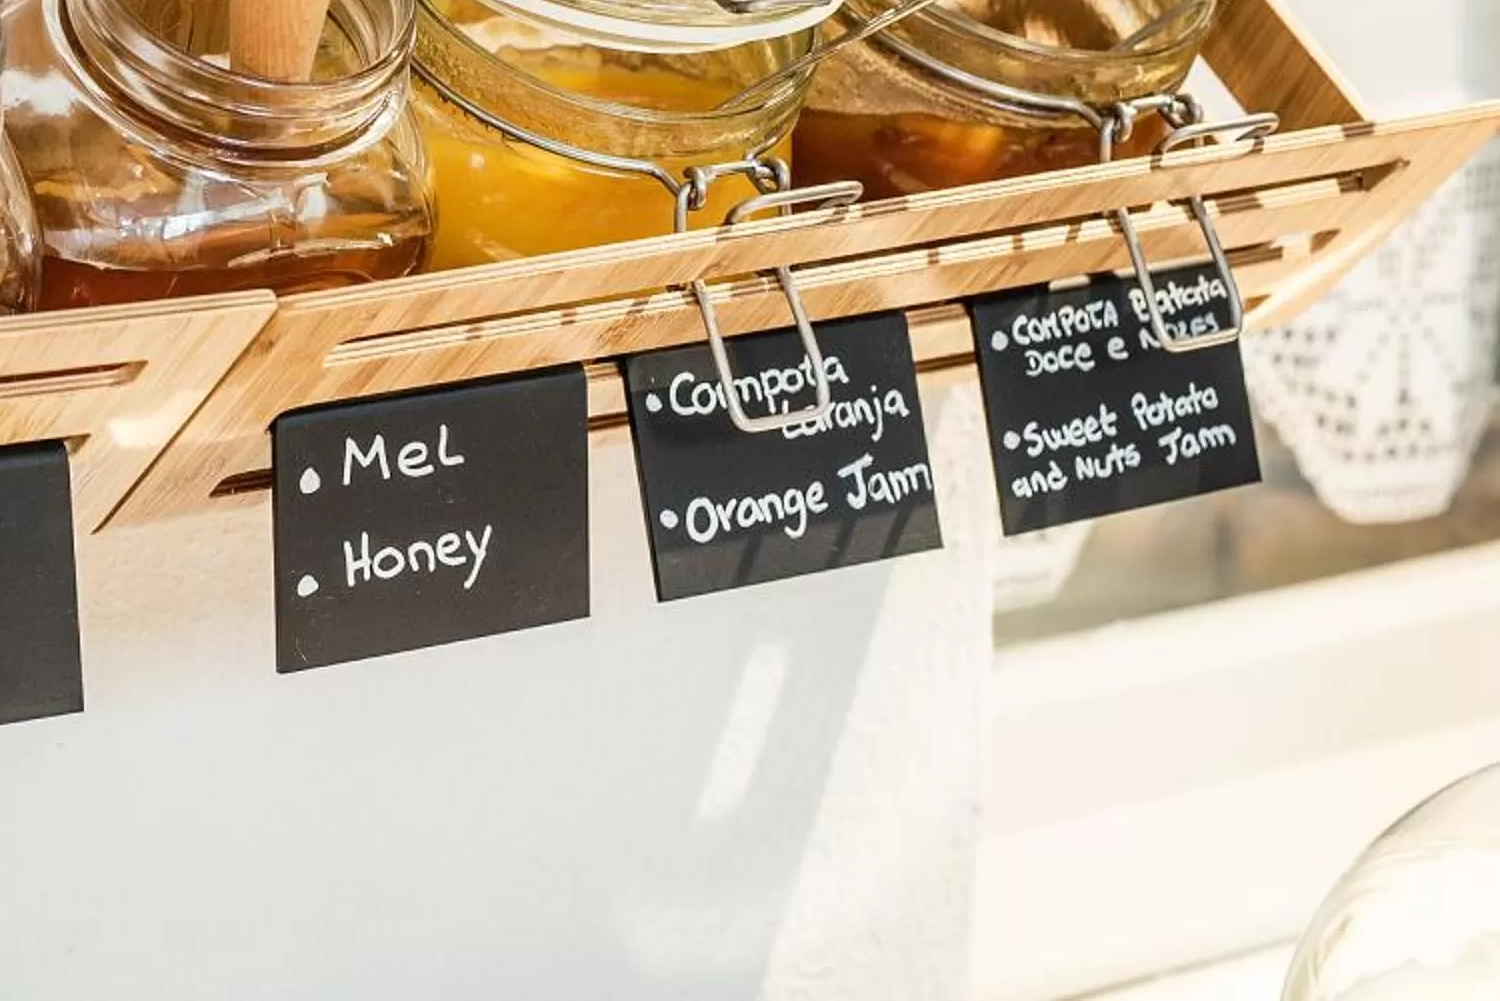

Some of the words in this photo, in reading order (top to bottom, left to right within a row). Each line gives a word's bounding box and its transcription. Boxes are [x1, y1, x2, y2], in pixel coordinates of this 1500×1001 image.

[1023, 403, 1117, 457] Sweet
[1131, 382, 1218, 430] Potato
[684, 480, 829, 544] Orange
[837, 452, 933, 510] Jam
[1011, 460, 1068, 498] and
[1075, 444, 1141, 480] Nuts
[1158, 423, 1237, 465] Jam
[343, 524, 493, 590] Honey
